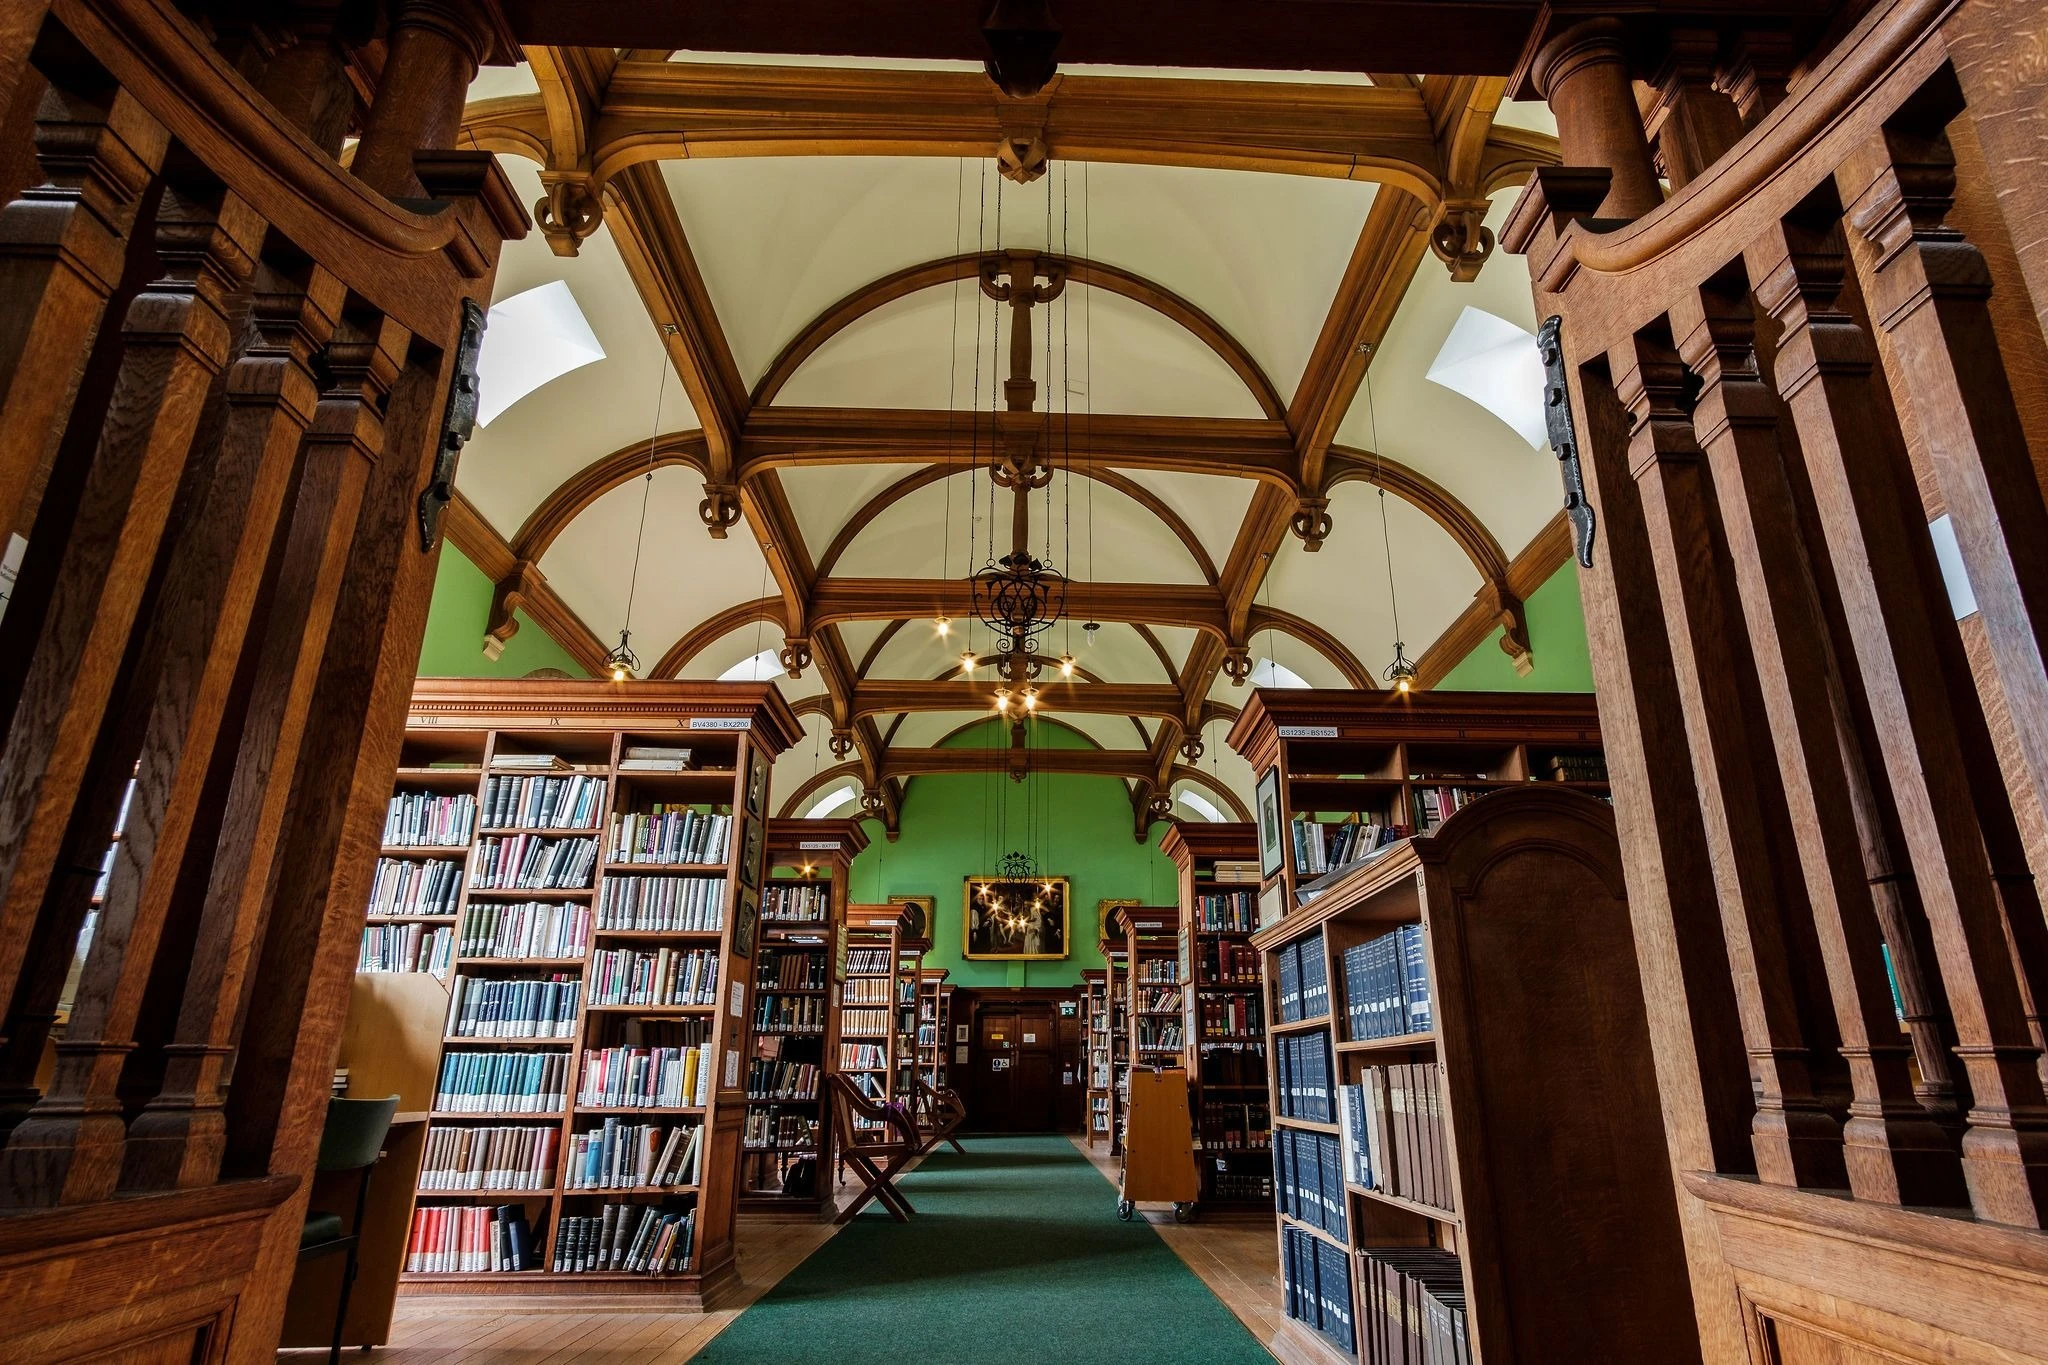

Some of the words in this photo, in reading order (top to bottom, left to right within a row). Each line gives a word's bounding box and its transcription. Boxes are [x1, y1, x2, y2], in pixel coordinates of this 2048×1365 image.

[550, 717, 561, 726] IX
[676, 719, 685, 728] X
[1440, 1062, 1445, 1075] 6
